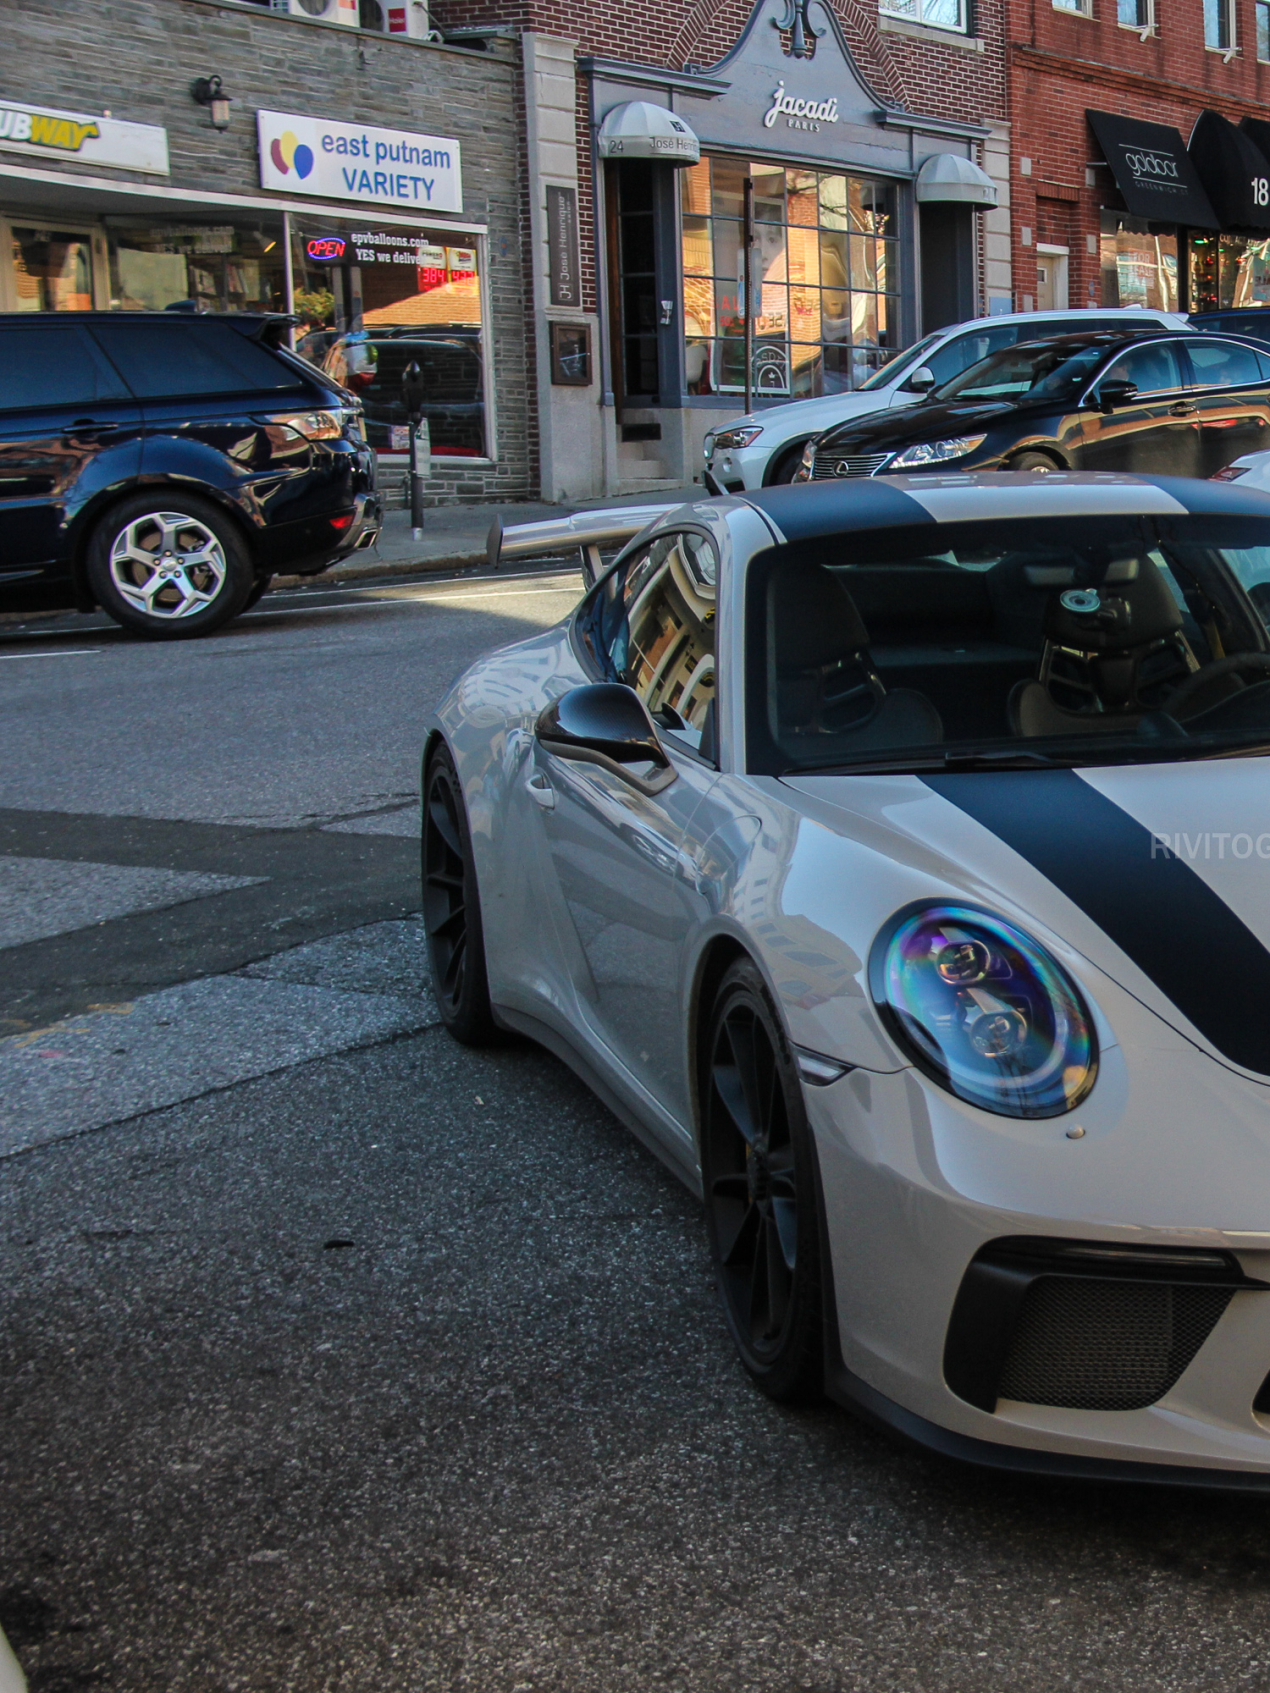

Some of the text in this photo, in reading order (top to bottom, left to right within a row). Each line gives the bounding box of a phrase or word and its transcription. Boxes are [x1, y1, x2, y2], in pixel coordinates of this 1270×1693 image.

[764, 80, 839, 130] jacadi
[0, 109, 99, 151] UBWAY
[788, 119, 820, 133] PARIS
[321, 134, 450, 169] east putnam
[610, 139, 624, 154] 24
[342, 167, 435, 201] VARIETY
[1250, 177, 1270, 207] 18
[307, 239, 347, 258] OPEN
[351, 232, 429, 248] epvballoons.com
[356, 248, 375, 262] YES
[377, 251, 391, 263] we
[393, 251, 422, 265] delive
[421, 267, 446, 284] 384
